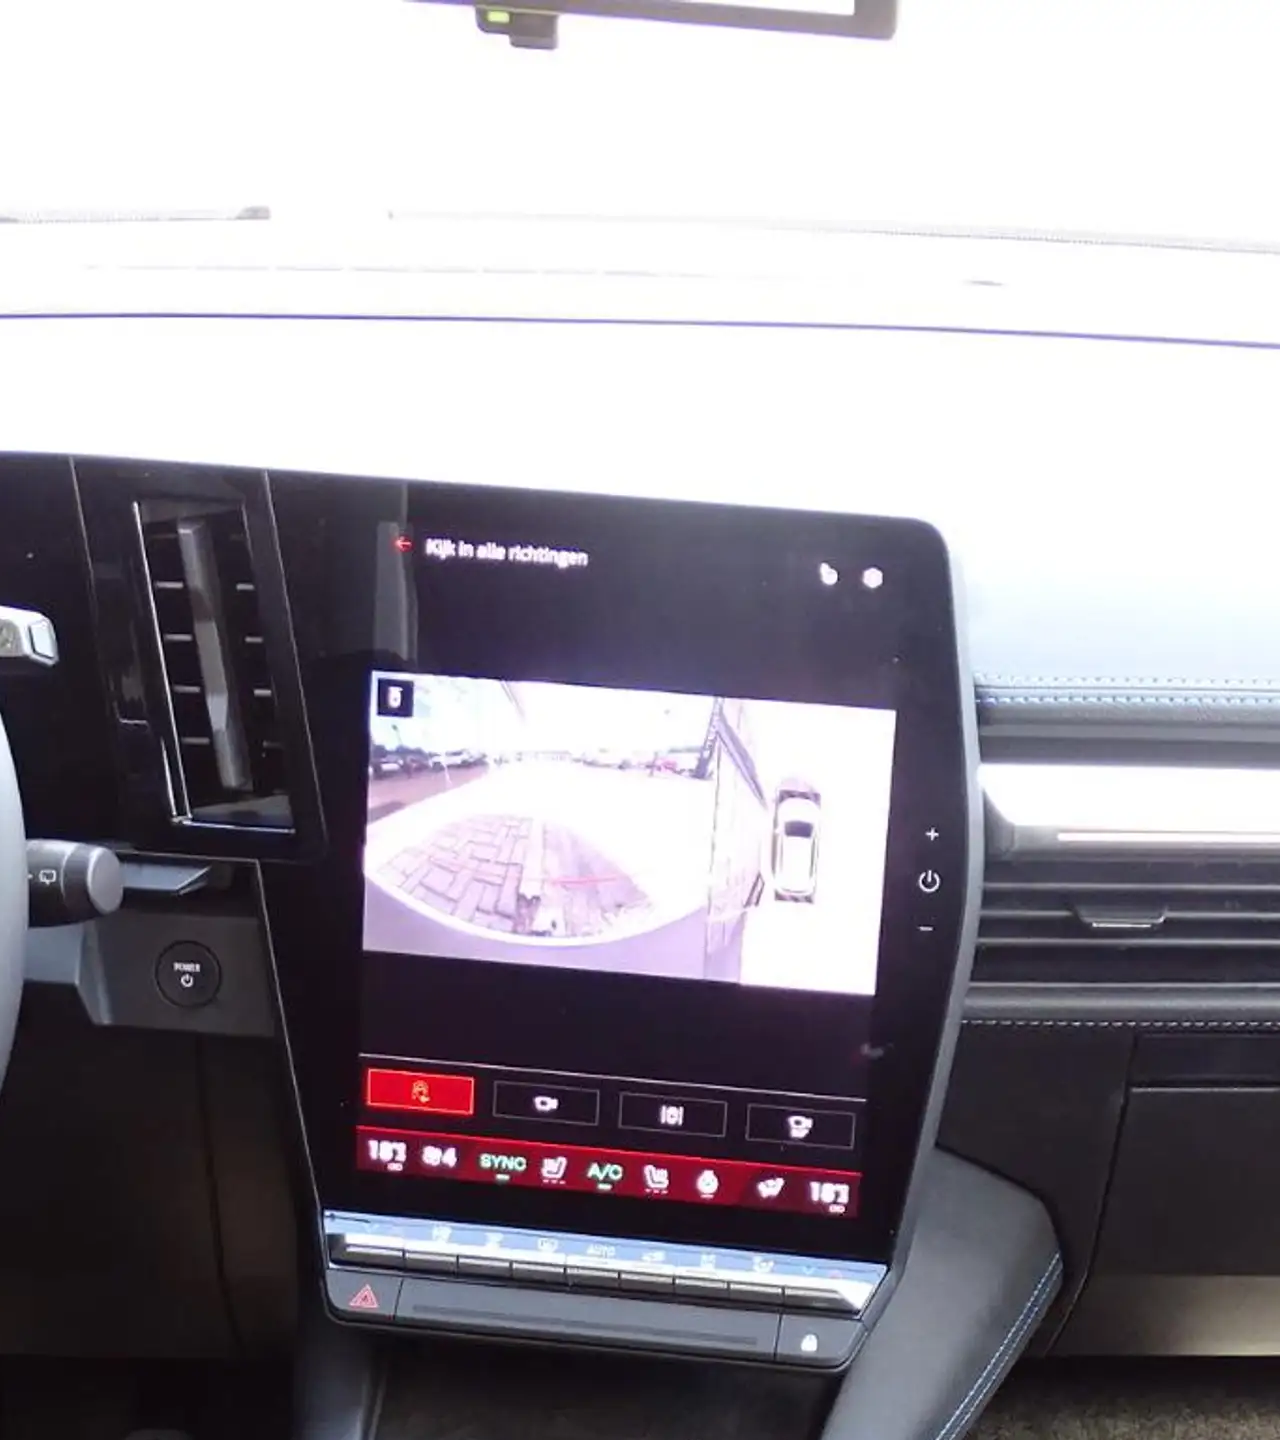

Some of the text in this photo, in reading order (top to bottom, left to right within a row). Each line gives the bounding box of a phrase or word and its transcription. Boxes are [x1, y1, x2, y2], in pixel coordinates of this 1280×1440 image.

[426, 538, 589, 569] Kijk in alle richtingen
[479, 1153, 527, 1172] SYNC
[587, 1162, 623, 1181] A/C
